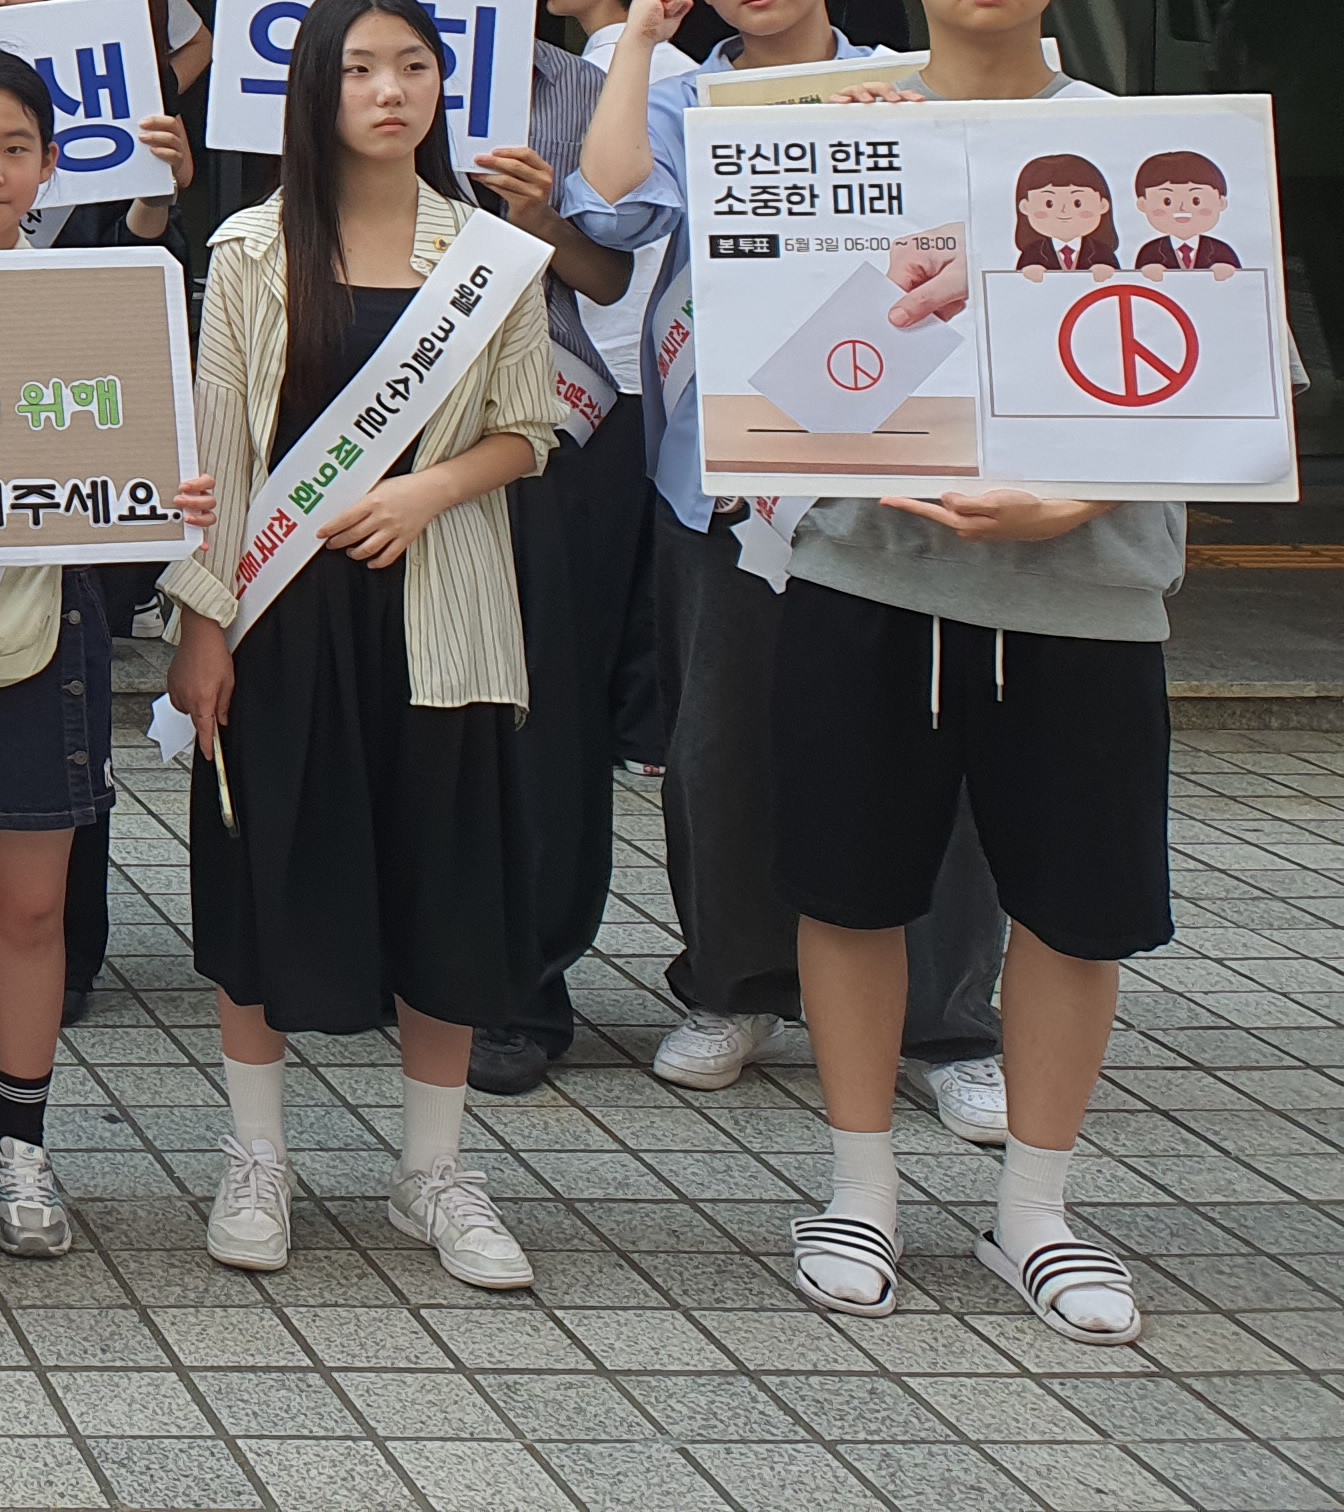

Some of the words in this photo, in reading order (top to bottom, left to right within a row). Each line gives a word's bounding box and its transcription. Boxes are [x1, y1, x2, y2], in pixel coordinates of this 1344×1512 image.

[711, 141, 817, 176] 당신의
[828, 140, 902, 174] 한표
[713, 183, 820, 217] 소중한
[832, 182, 904, 216] 미래
[784, 238, 810, 252] 6월
[814, 238, 840, 252] 3일
[844, 237, 890, 251] 06:00
[913, 236, 957, 251] 18:00
[449, 265, 494, 318] 6월
[17, 377, 121, 429] 위해
[353, 319, 456, 440] 3일(수)은
[287, 434, 365, 516] 제9회
